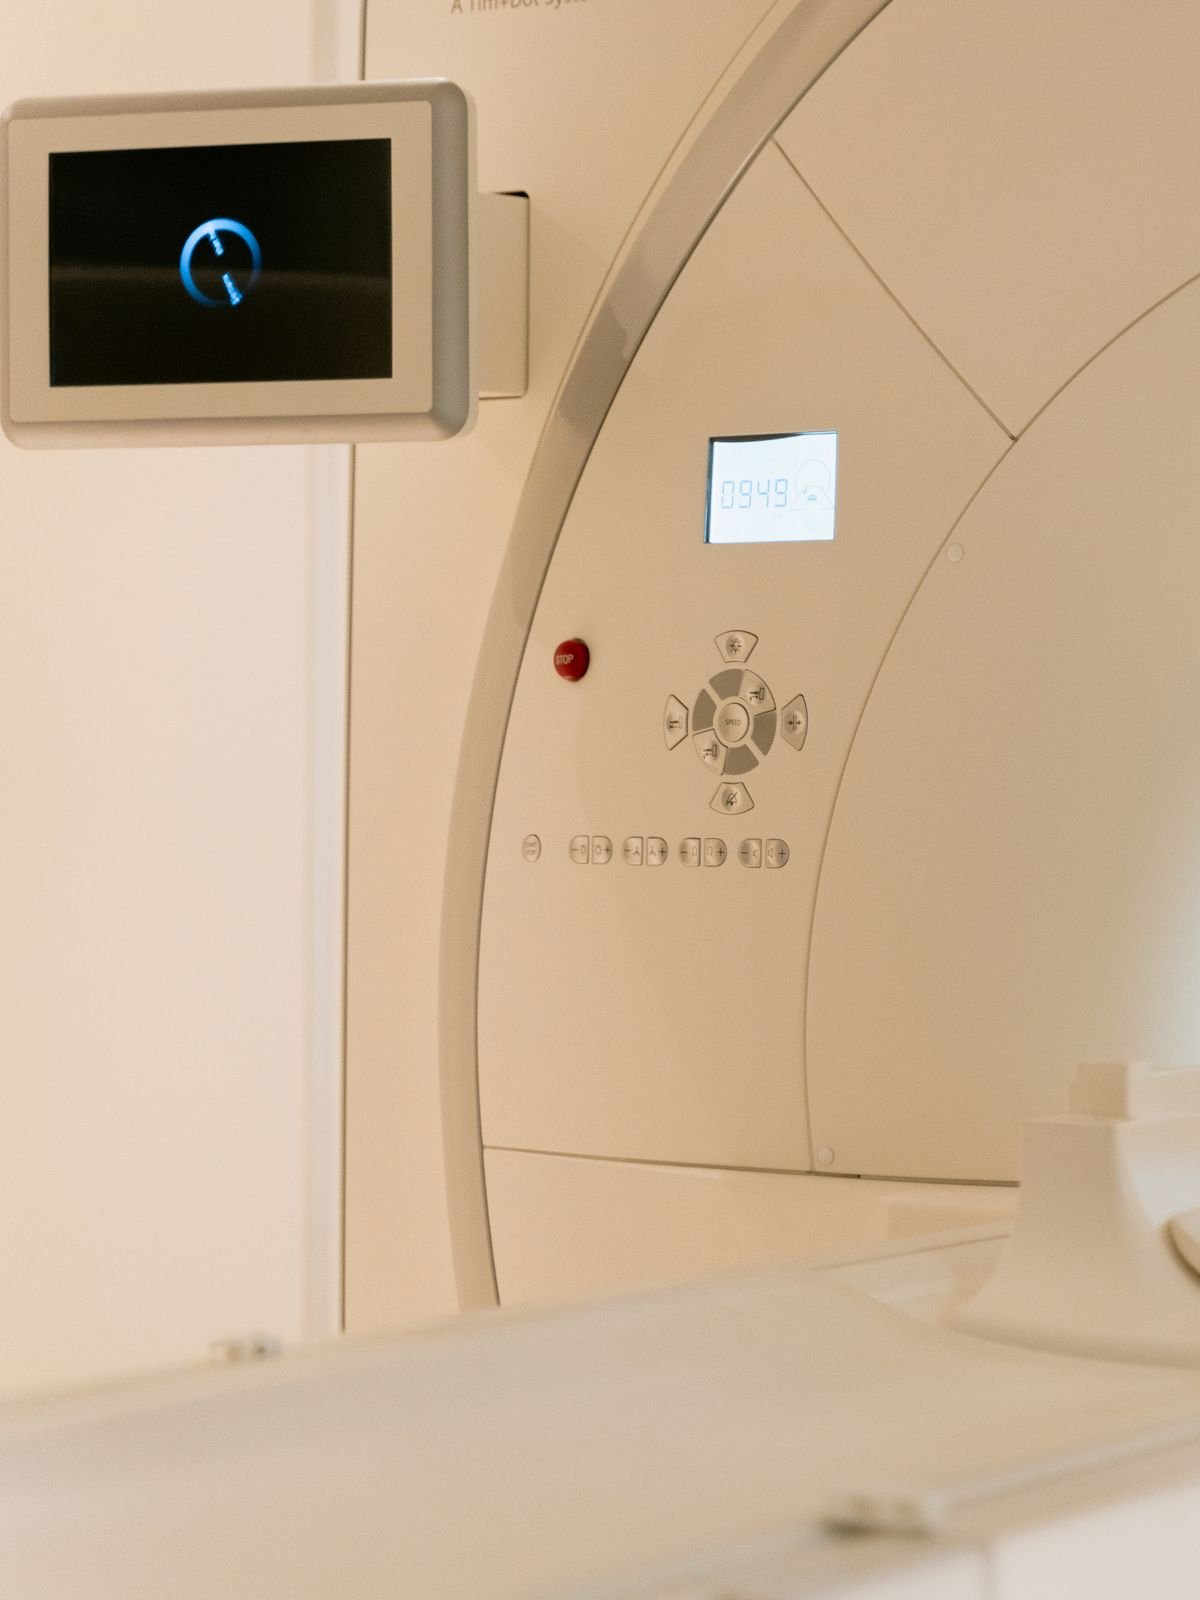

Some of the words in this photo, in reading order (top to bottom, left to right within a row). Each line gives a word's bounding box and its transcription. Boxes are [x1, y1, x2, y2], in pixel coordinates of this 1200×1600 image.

[450, 0, 464, 14] A
[721, 478, 788, 510] 0949
[555, 653, 574, 666] STOP
